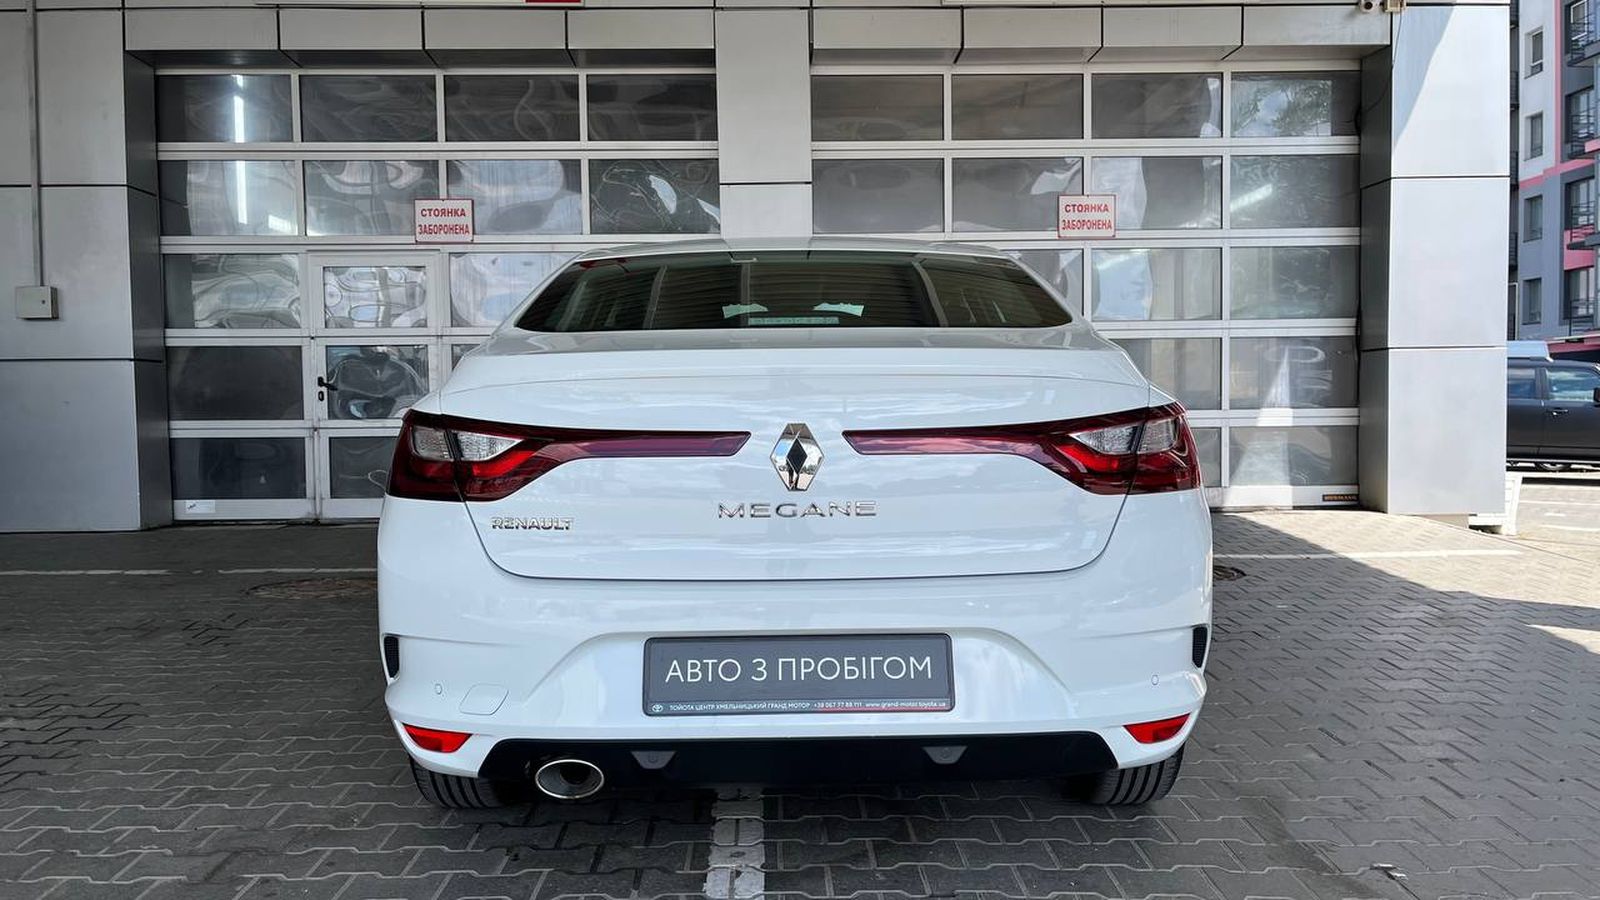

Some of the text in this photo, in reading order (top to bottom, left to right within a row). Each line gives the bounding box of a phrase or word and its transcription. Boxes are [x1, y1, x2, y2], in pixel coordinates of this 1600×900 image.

[420, 208, 466, 217] СТОЯНКА
[1064, 204, 1110, 213] СТОЯНКА
[418, 224, 470, 235] ЗАБОРОНЕНА
[1062, 219, 1112, 230] ЗАБОРОНЕНА
[718, 500, 877, 518] MEGANE
[491, 516, 574, 530] RENAULT
[665, 656, 932, 683] АВТО З ПРОБІГОМ
